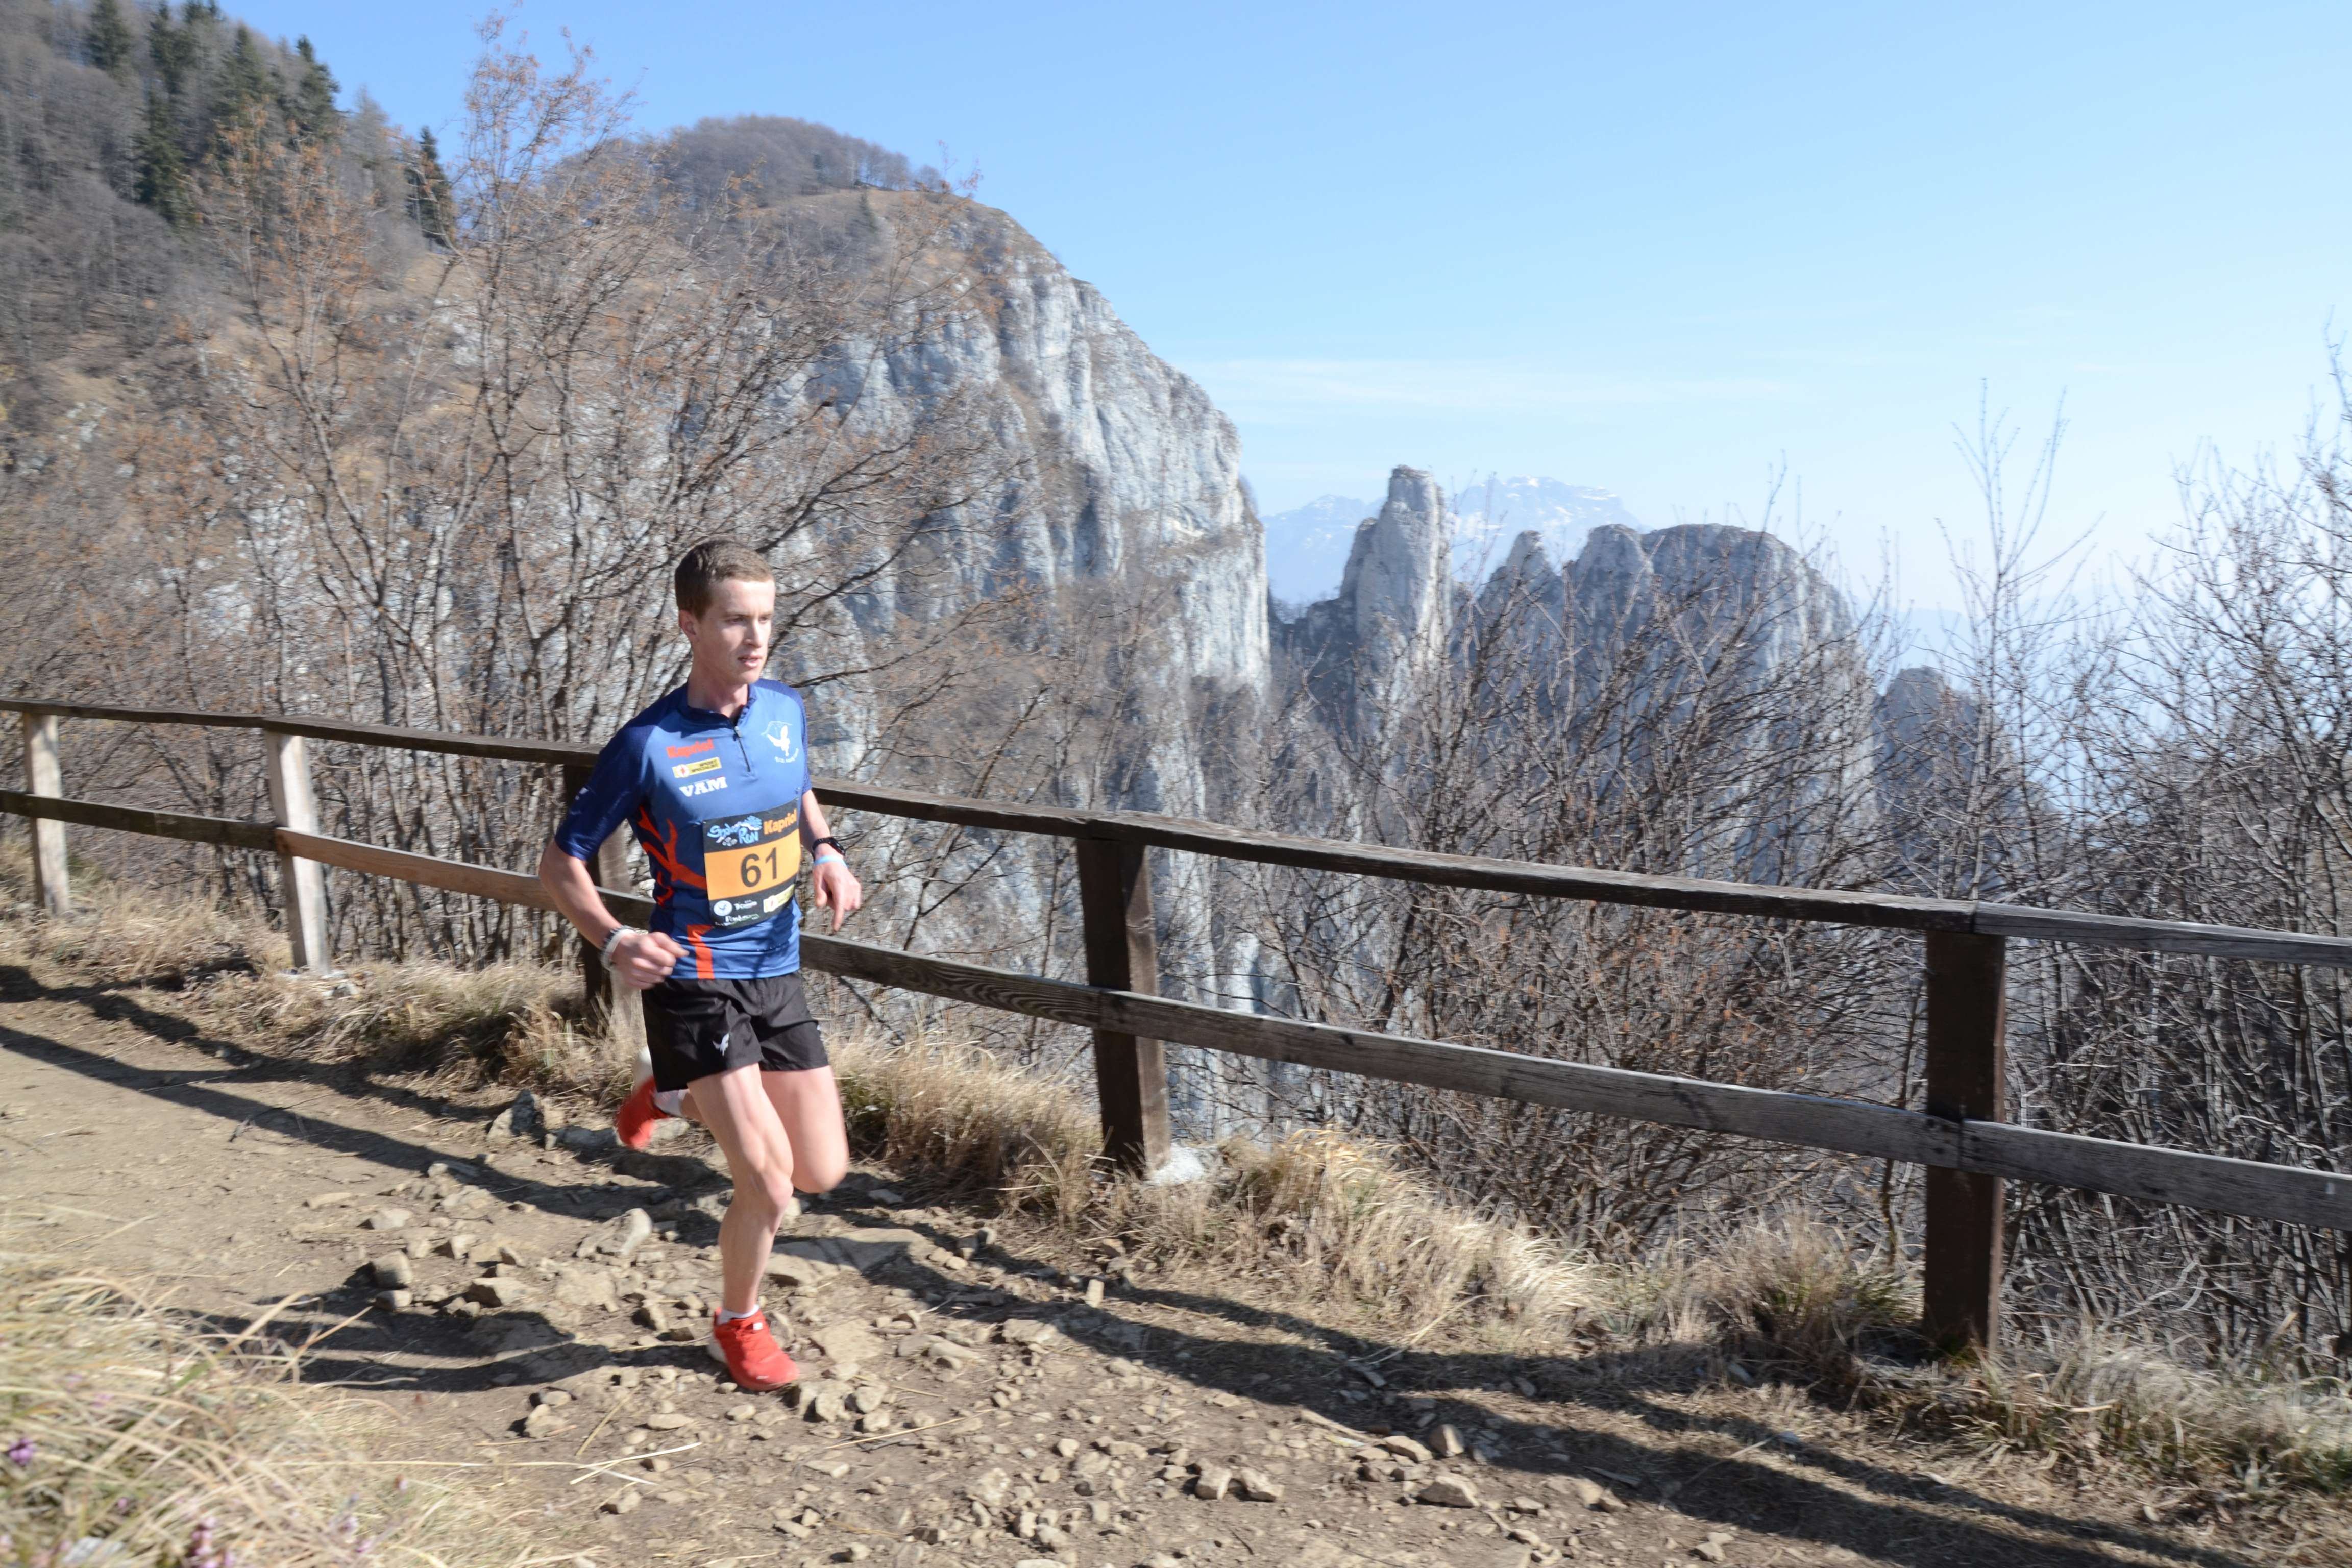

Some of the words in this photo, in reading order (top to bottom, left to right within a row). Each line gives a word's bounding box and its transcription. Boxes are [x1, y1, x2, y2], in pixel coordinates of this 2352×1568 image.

[679, 777, 728, 797] VAM
[764, 808, 797, 835] Kapriol
[741, 847, 777, 887] 61
